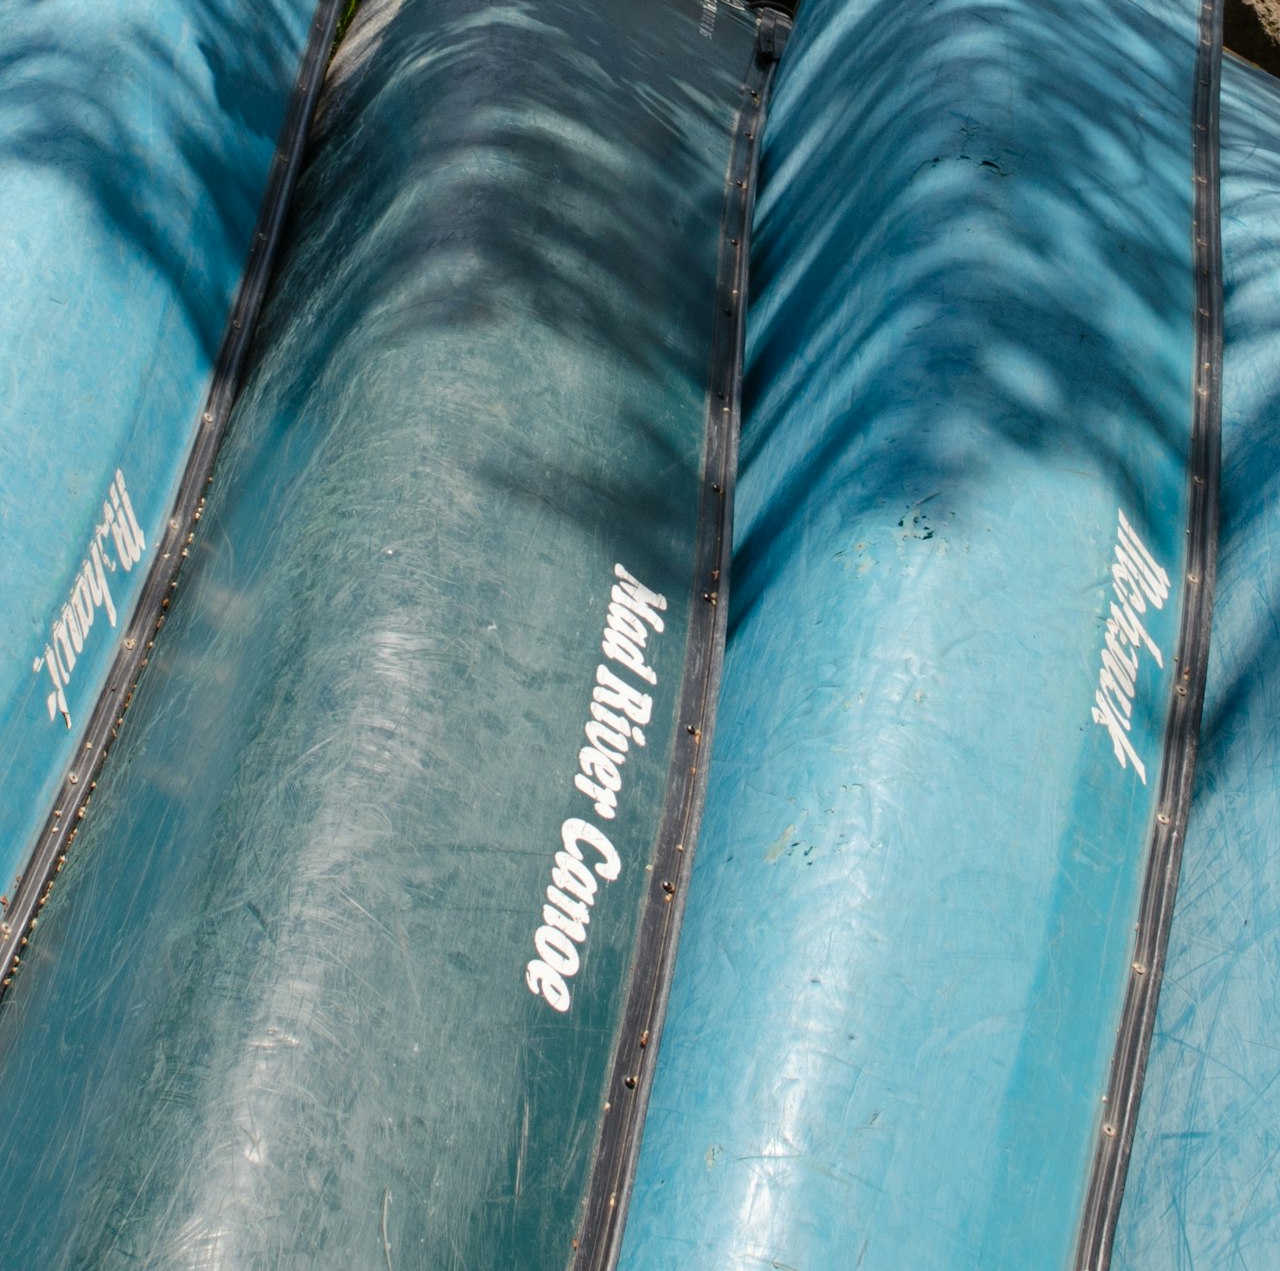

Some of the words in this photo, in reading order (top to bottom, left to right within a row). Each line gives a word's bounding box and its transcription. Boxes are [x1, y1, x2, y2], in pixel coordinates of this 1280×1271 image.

[602, 563, 667, 685] Mad
[574, 664, 653, 820] River
[525, 817, 622, 1013] Canoe
